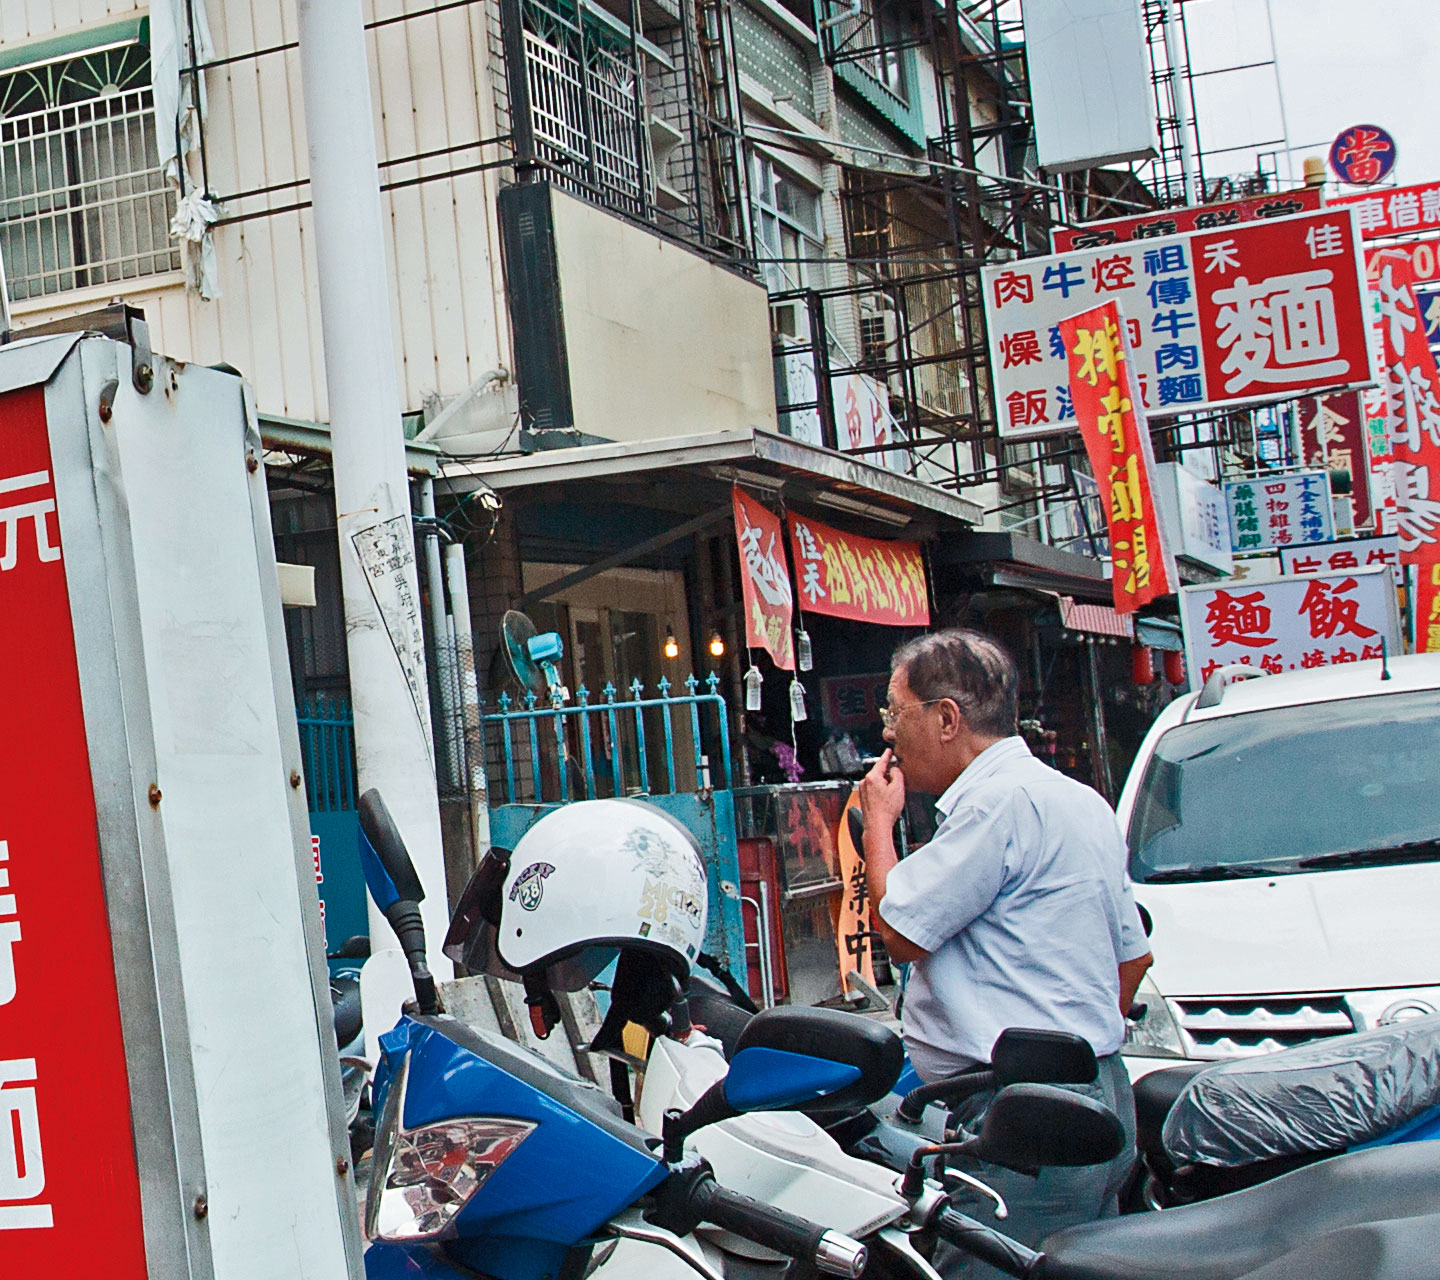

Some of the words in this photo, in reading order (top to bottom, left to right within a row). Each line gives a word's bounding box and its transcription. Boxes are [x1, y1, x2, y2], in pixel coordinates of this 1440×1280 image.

[1337, 129, 1390, 183] 當
[993, 271, 1050, 428] 肉燥飯
[1143, 244, 1203, 406] 祖傳牛肉麵
[1211, 268, 1352, 395] 麵
[1264, 482, 1293, 545] 四物雞湯
[1294, 477, 1325, 543] 十全大補湯
[521, 882, 542, 906] 28
